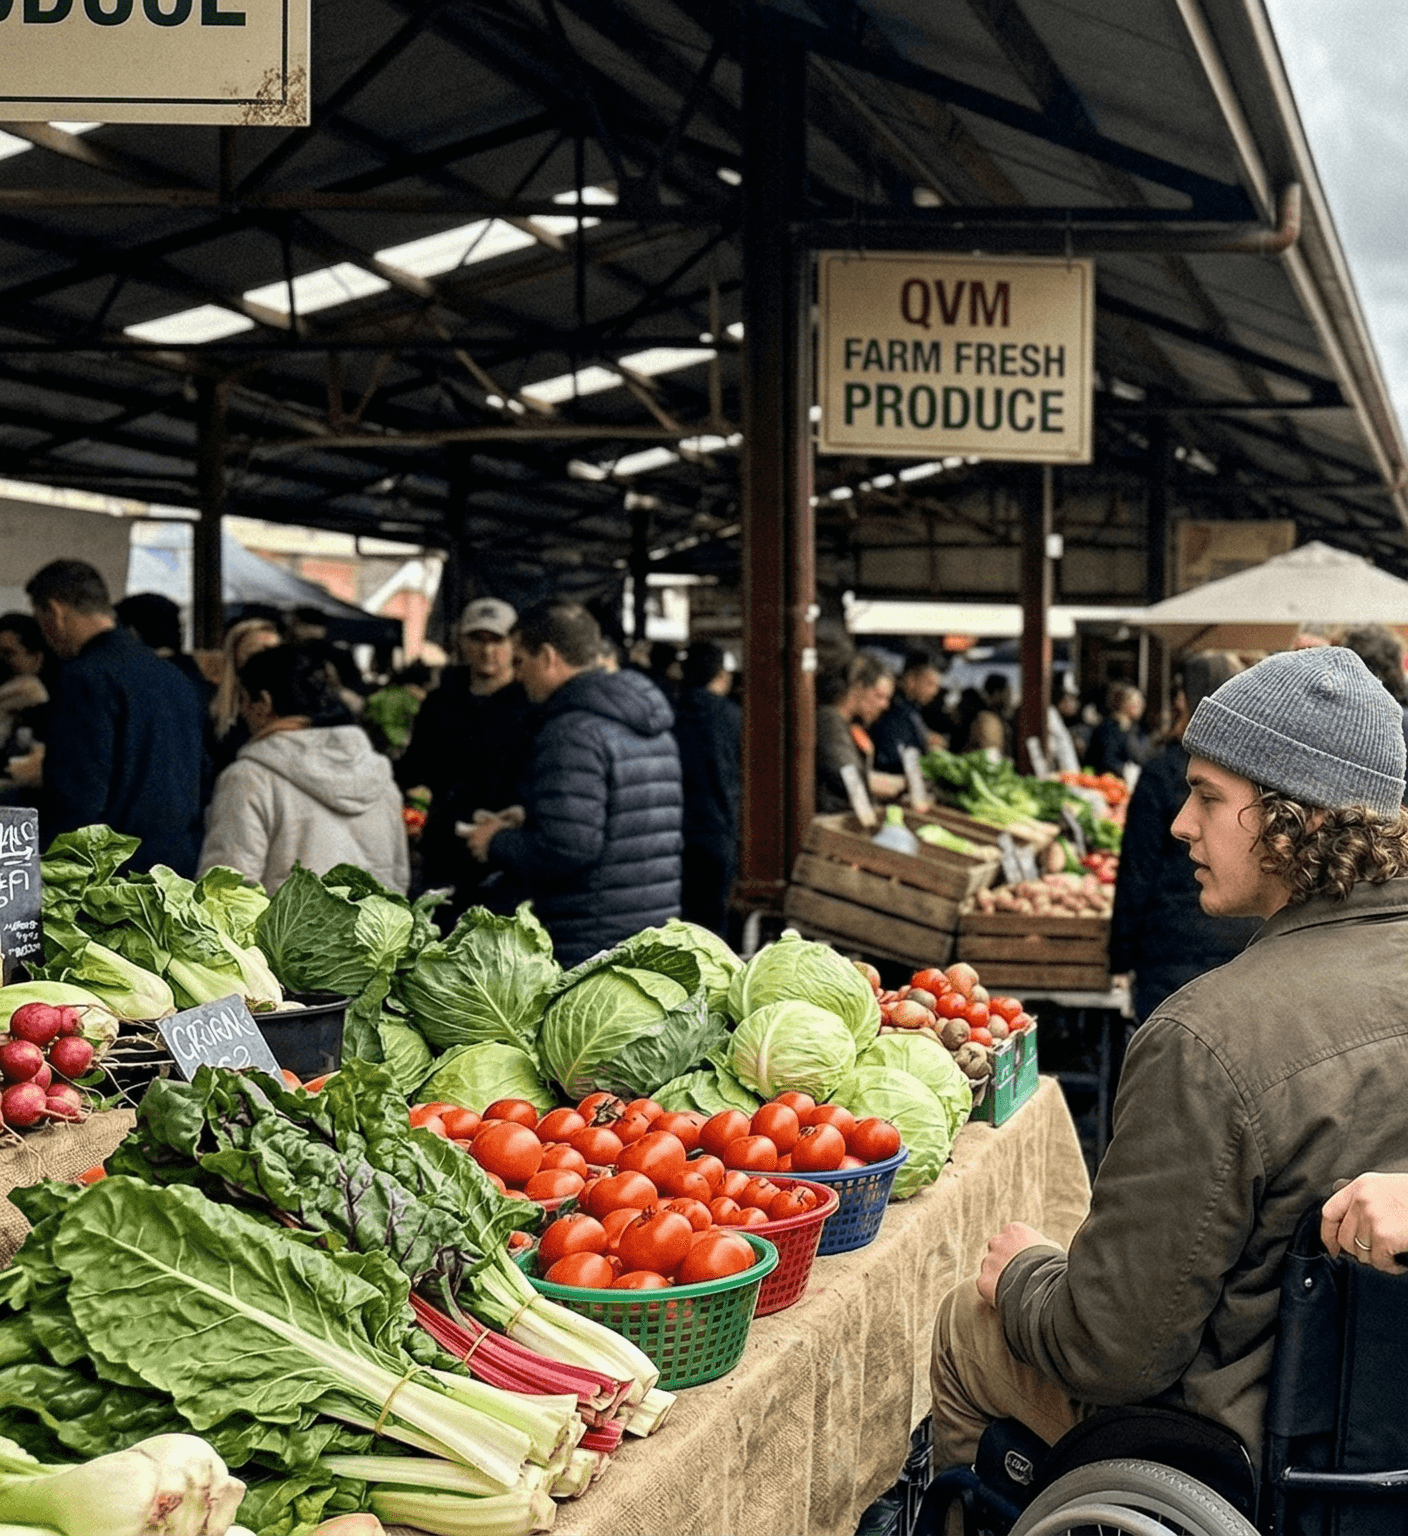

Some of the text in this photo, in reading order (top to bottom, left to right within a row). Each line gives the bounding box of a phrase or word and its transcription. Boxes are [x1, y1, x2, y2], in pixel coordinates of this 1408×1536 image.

[900, 277, 1010, 329] QVM
[844, 337, 1066, 379] FARM FRESH
[844, 381, 1065, 434] PRODUCE
